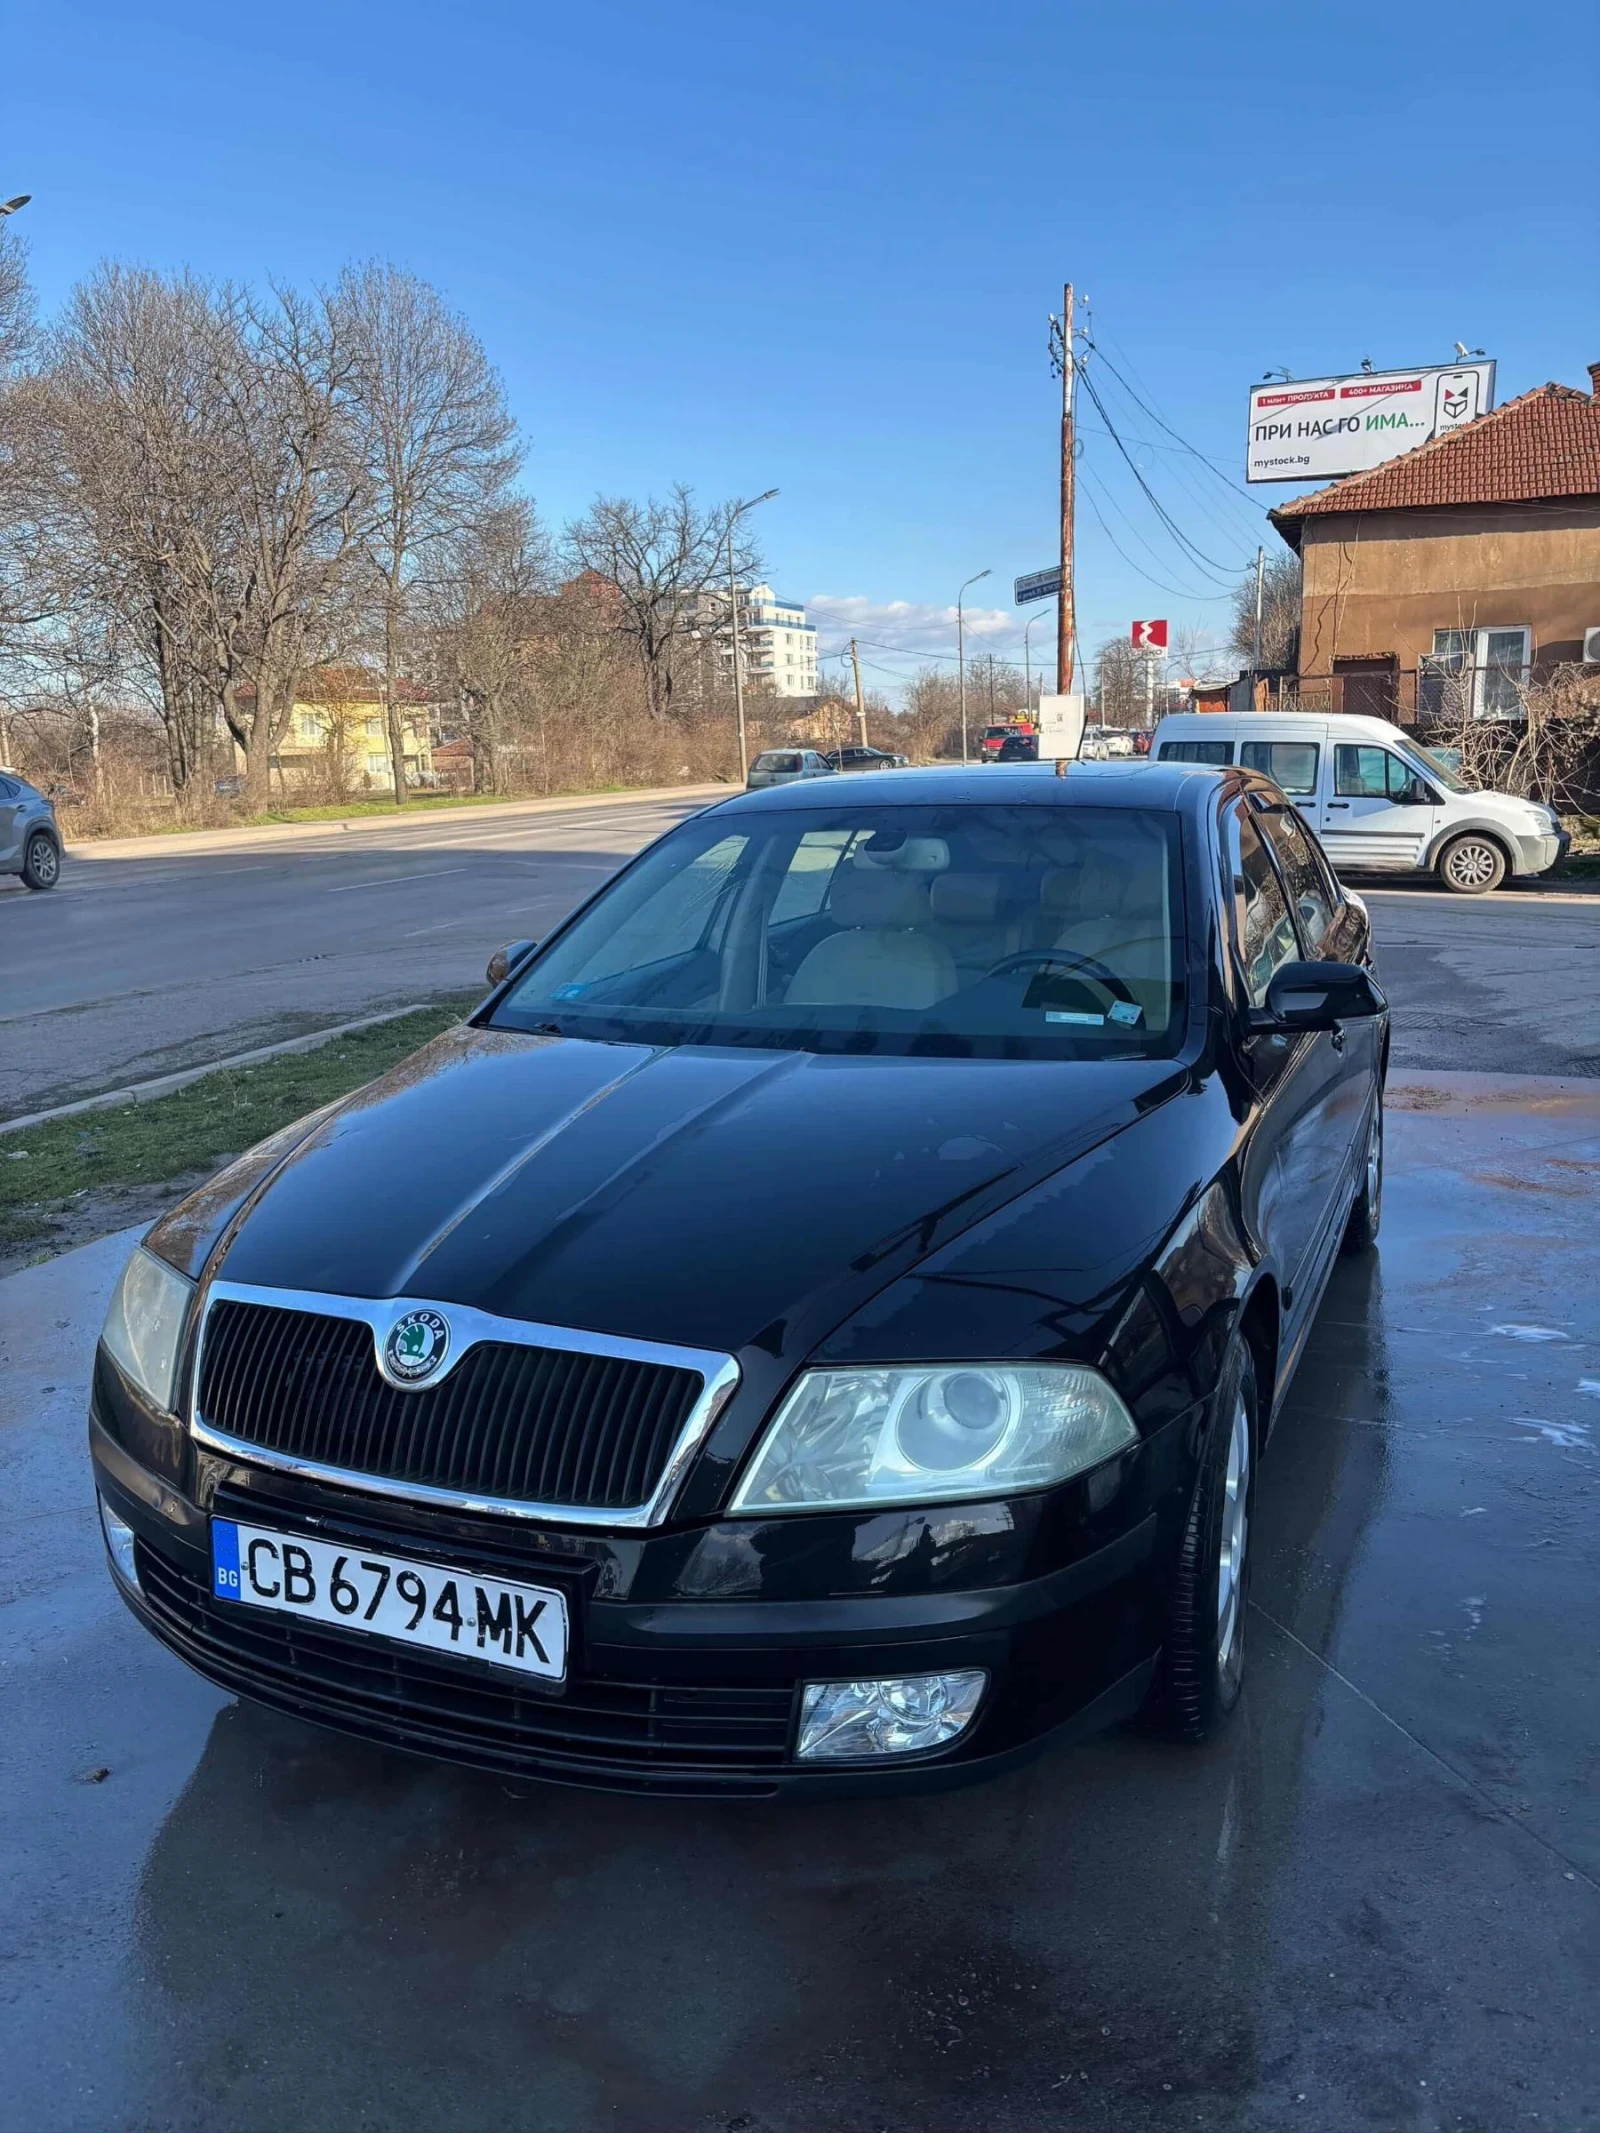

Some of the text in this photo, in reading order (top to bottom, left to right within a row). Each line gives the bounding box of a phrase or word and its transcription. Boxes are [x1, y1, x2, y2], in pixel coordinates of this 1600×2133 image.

[1287, 391, 1329, 402] ПРОДУКТА
[1348, 384, 1413, 395] 400+ МАГАЗИНА
[1255, 412, 1425, 441] ПРИ НАС ГО ИМА...
[1254, 455, 1310, 468] mystock.bg
[218, 1567, 238, 1588] BG
[248, 1538, 551, 1664] CB 6794 MK
